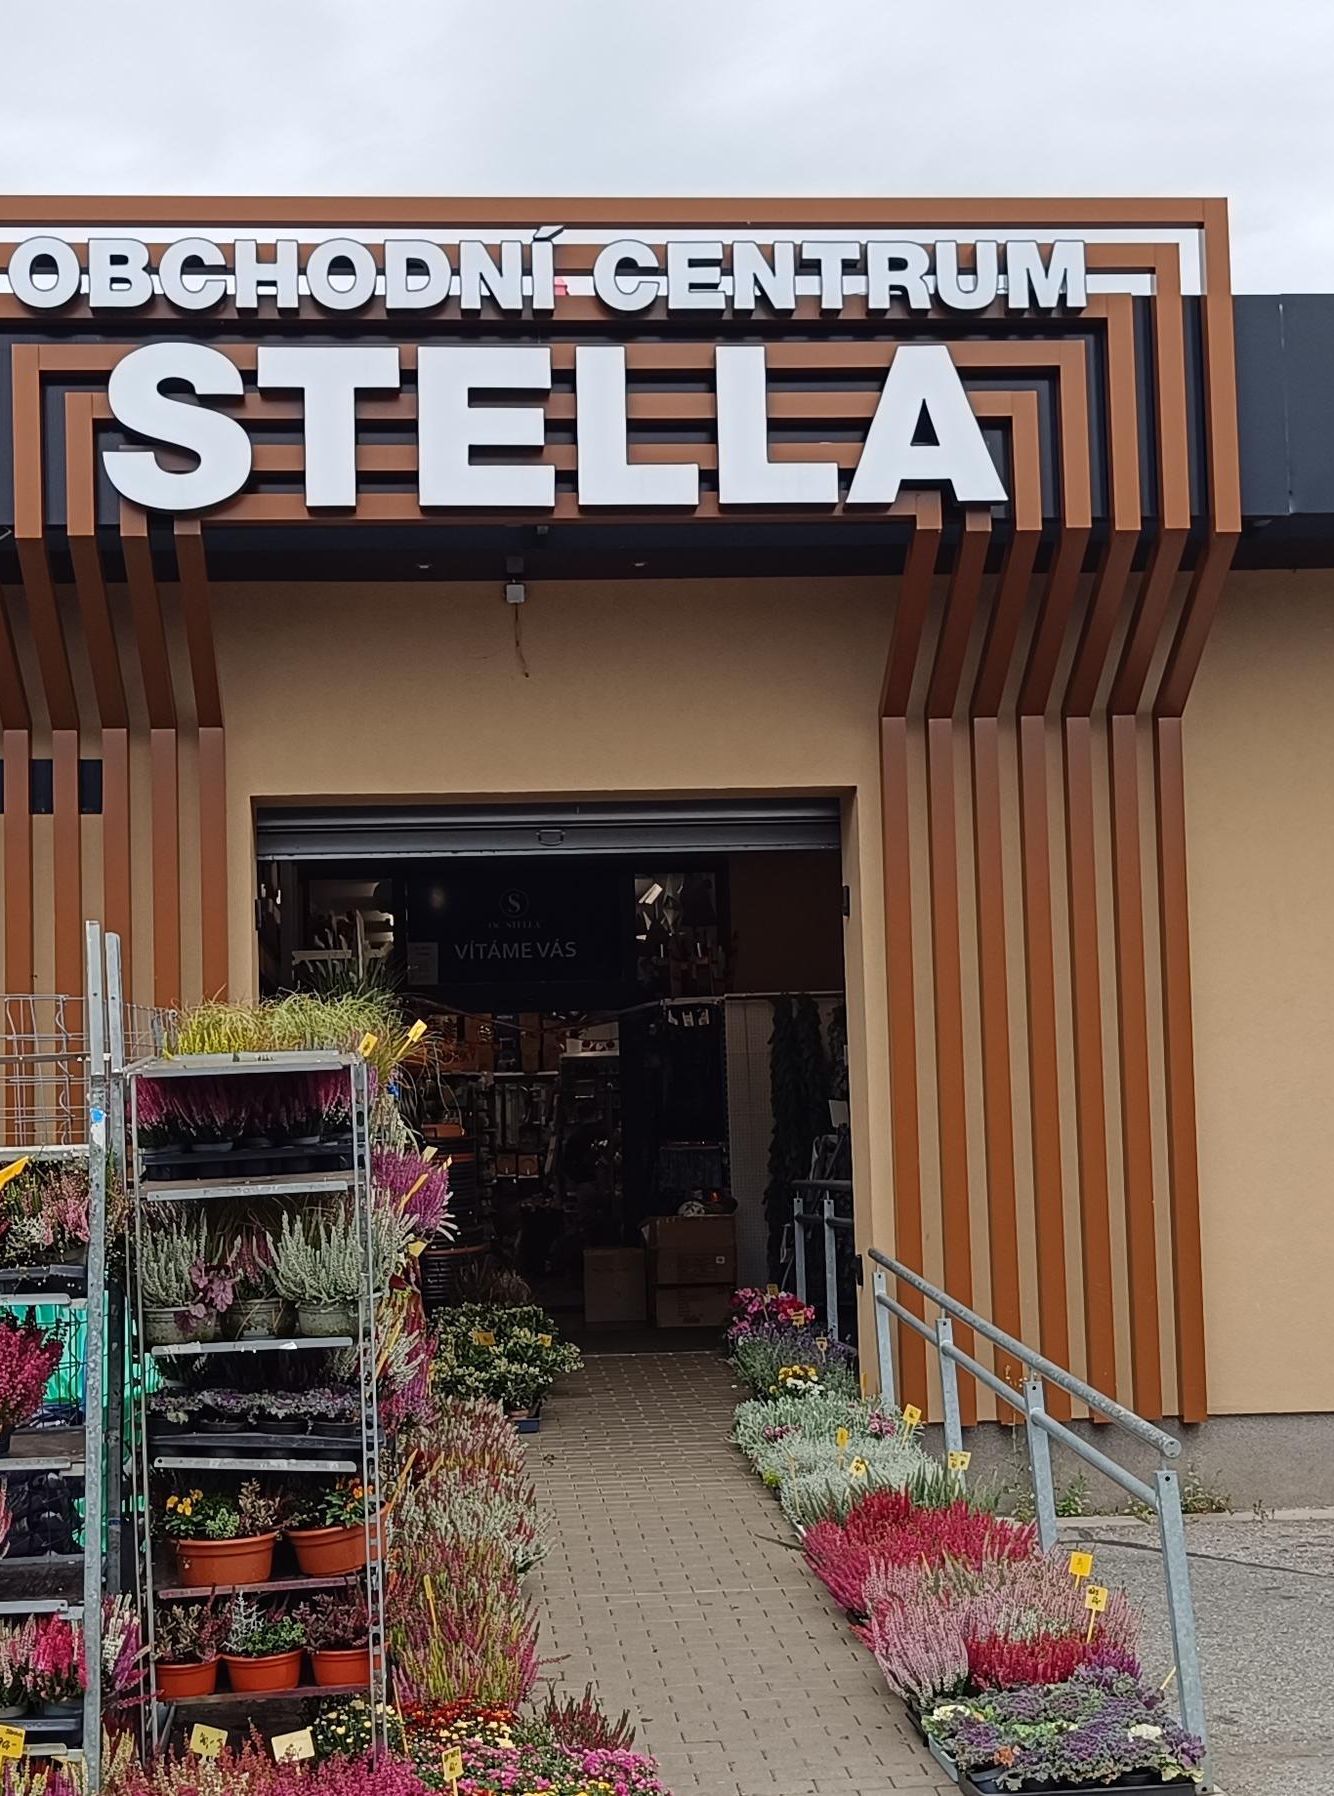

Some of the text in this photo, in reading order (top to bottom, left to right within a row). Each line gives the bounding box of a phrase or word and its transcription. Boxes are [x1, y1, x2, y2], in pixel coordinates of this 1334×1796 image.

[8, 225, 1087, 311] OBCHODNÍ CENTRUM
[102, 341, 1008, 511] STELLA
[454, 938, 577, 960] VÍTÁME VÁS
